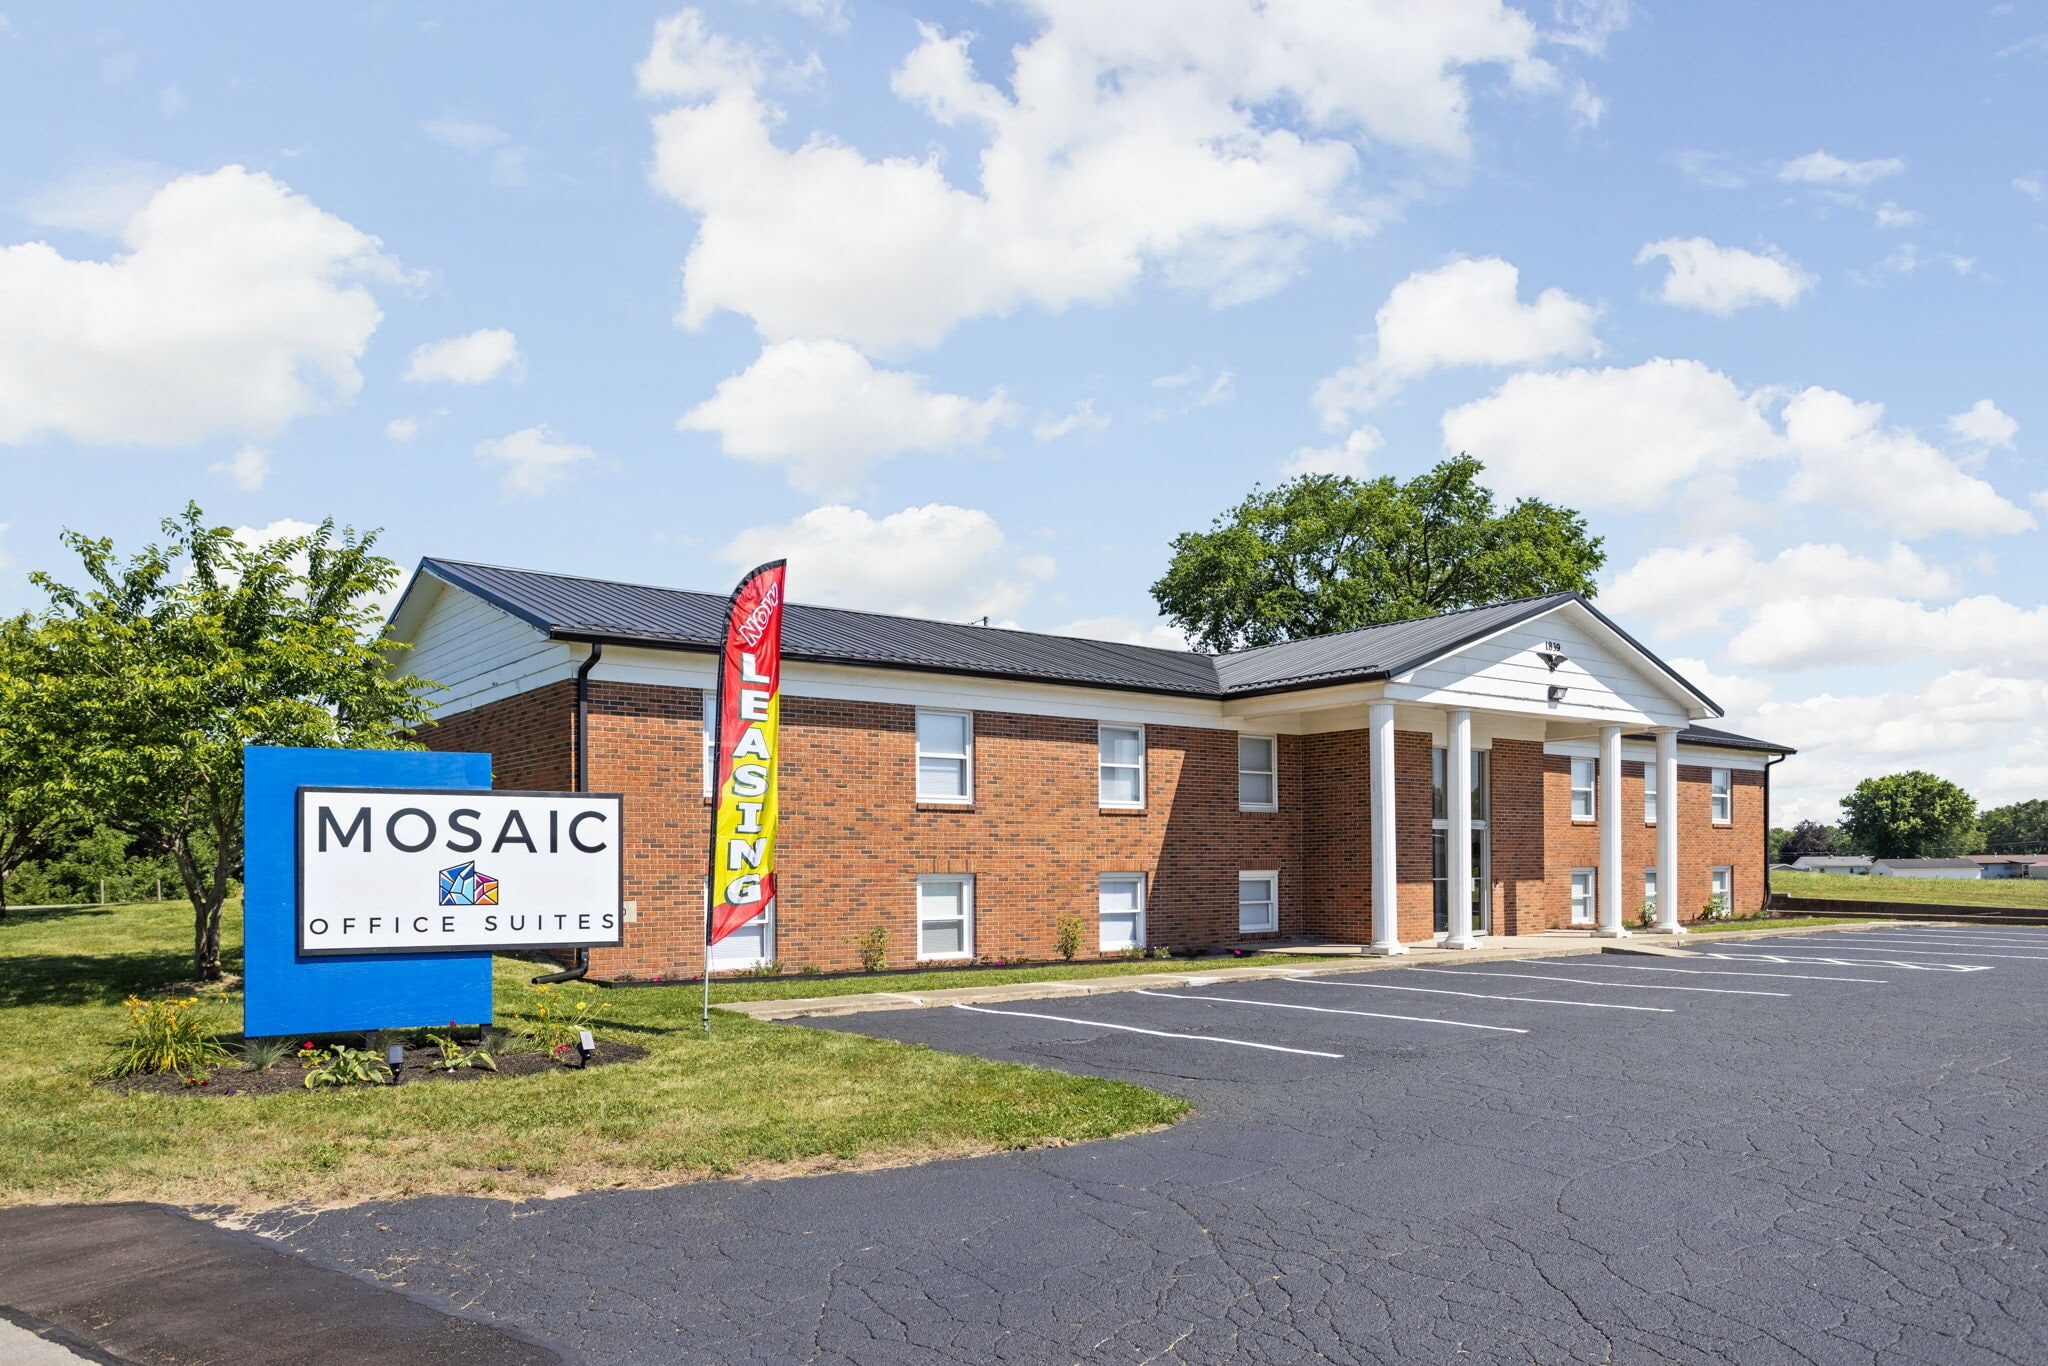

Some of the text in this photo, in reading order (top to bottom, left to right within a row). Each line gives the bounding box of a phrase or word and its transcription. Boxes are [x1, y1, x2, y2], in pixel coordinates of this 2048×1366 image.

[739, 581, 778, 647] NOW
[725, 652, 771, 906] LEASING
[318, 806, 607, 854] MOSAIC
[309, 913, 614, 935] OFFICE SUITES
